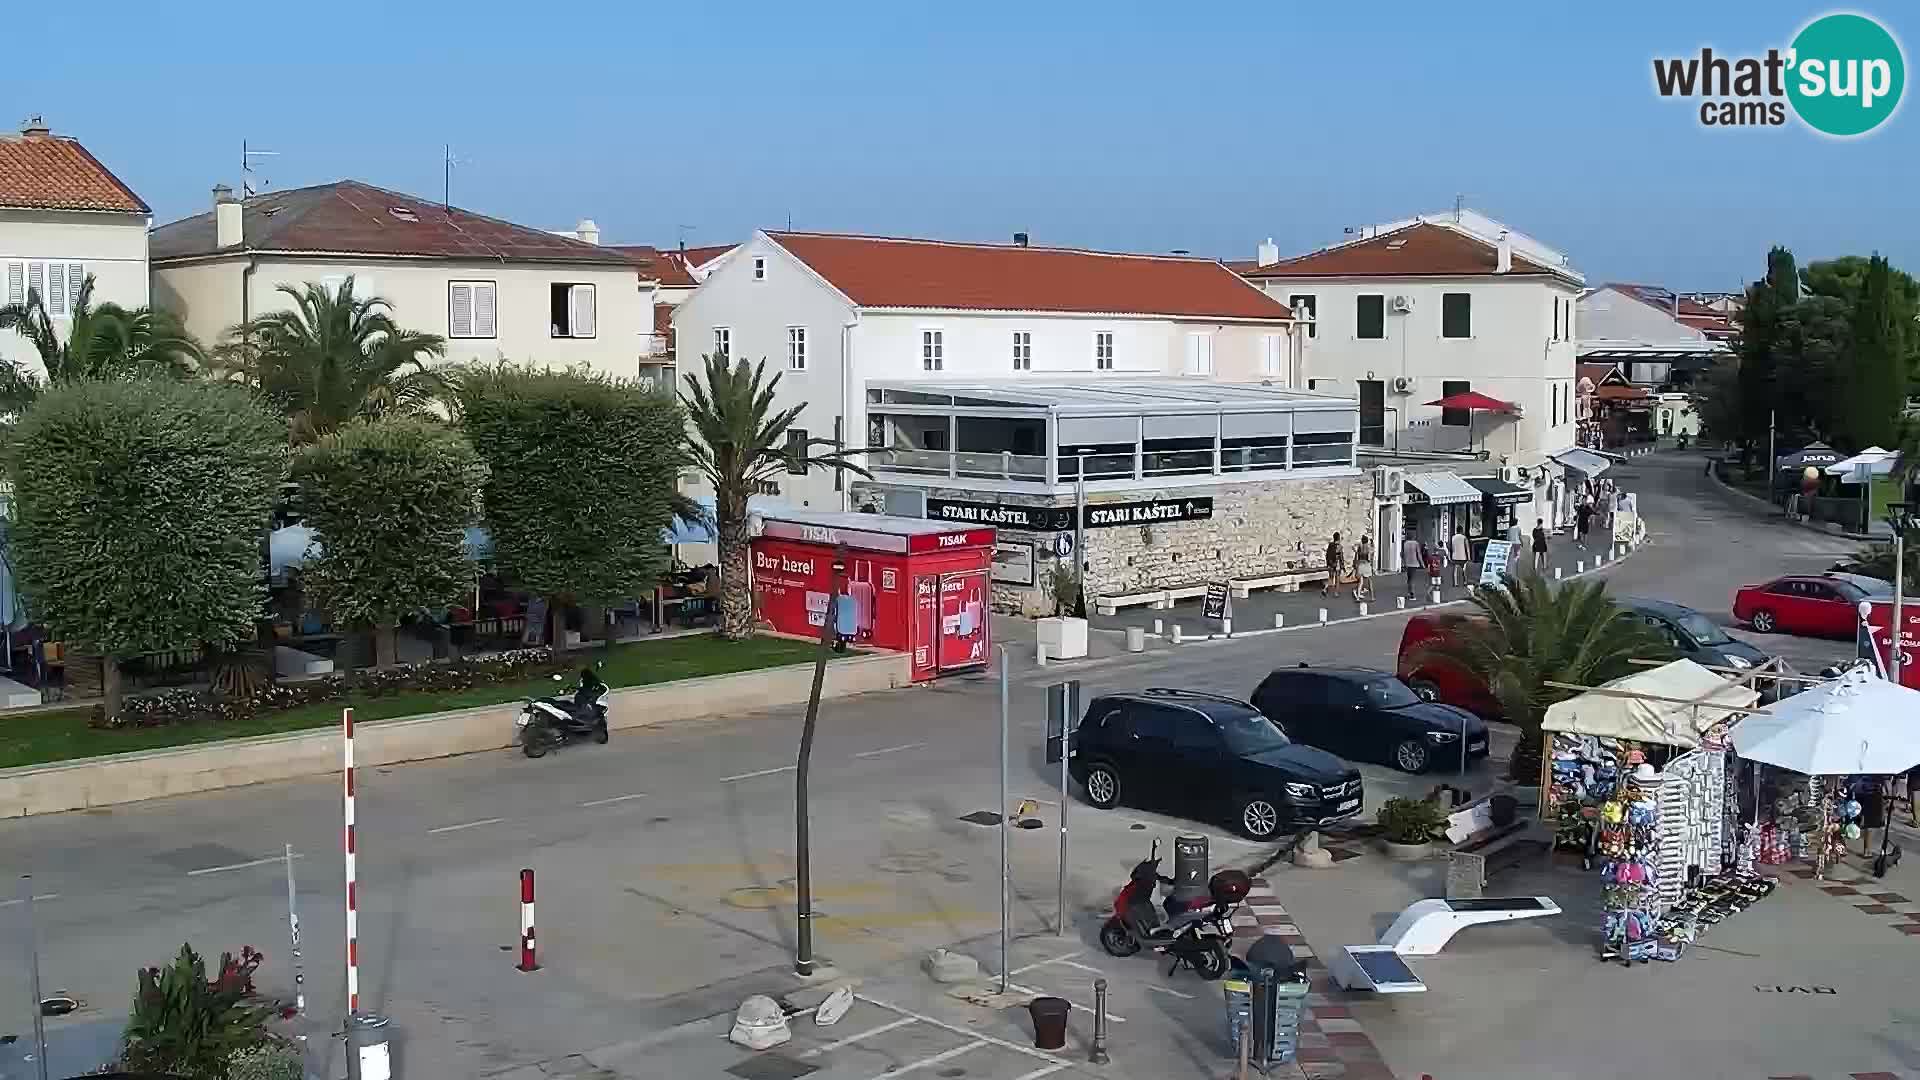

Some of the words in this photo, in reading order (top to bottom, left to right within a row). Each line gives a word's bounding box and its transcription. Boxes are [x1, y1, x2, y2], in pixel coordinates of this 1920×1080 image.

[942, 505, 978, 520] STARI
[980, 506, 1030, 525] KAŠTEL
[1091, 509, 1131, 524] STARI
[1133, 502, 1183, 520] KAŠTEL
[801, 527, 837, 543] TISAK
[938, 533, 968, 546] TISAK
[756, 551, 780, 570] Buy
[782, 554, 815, 576] here!
